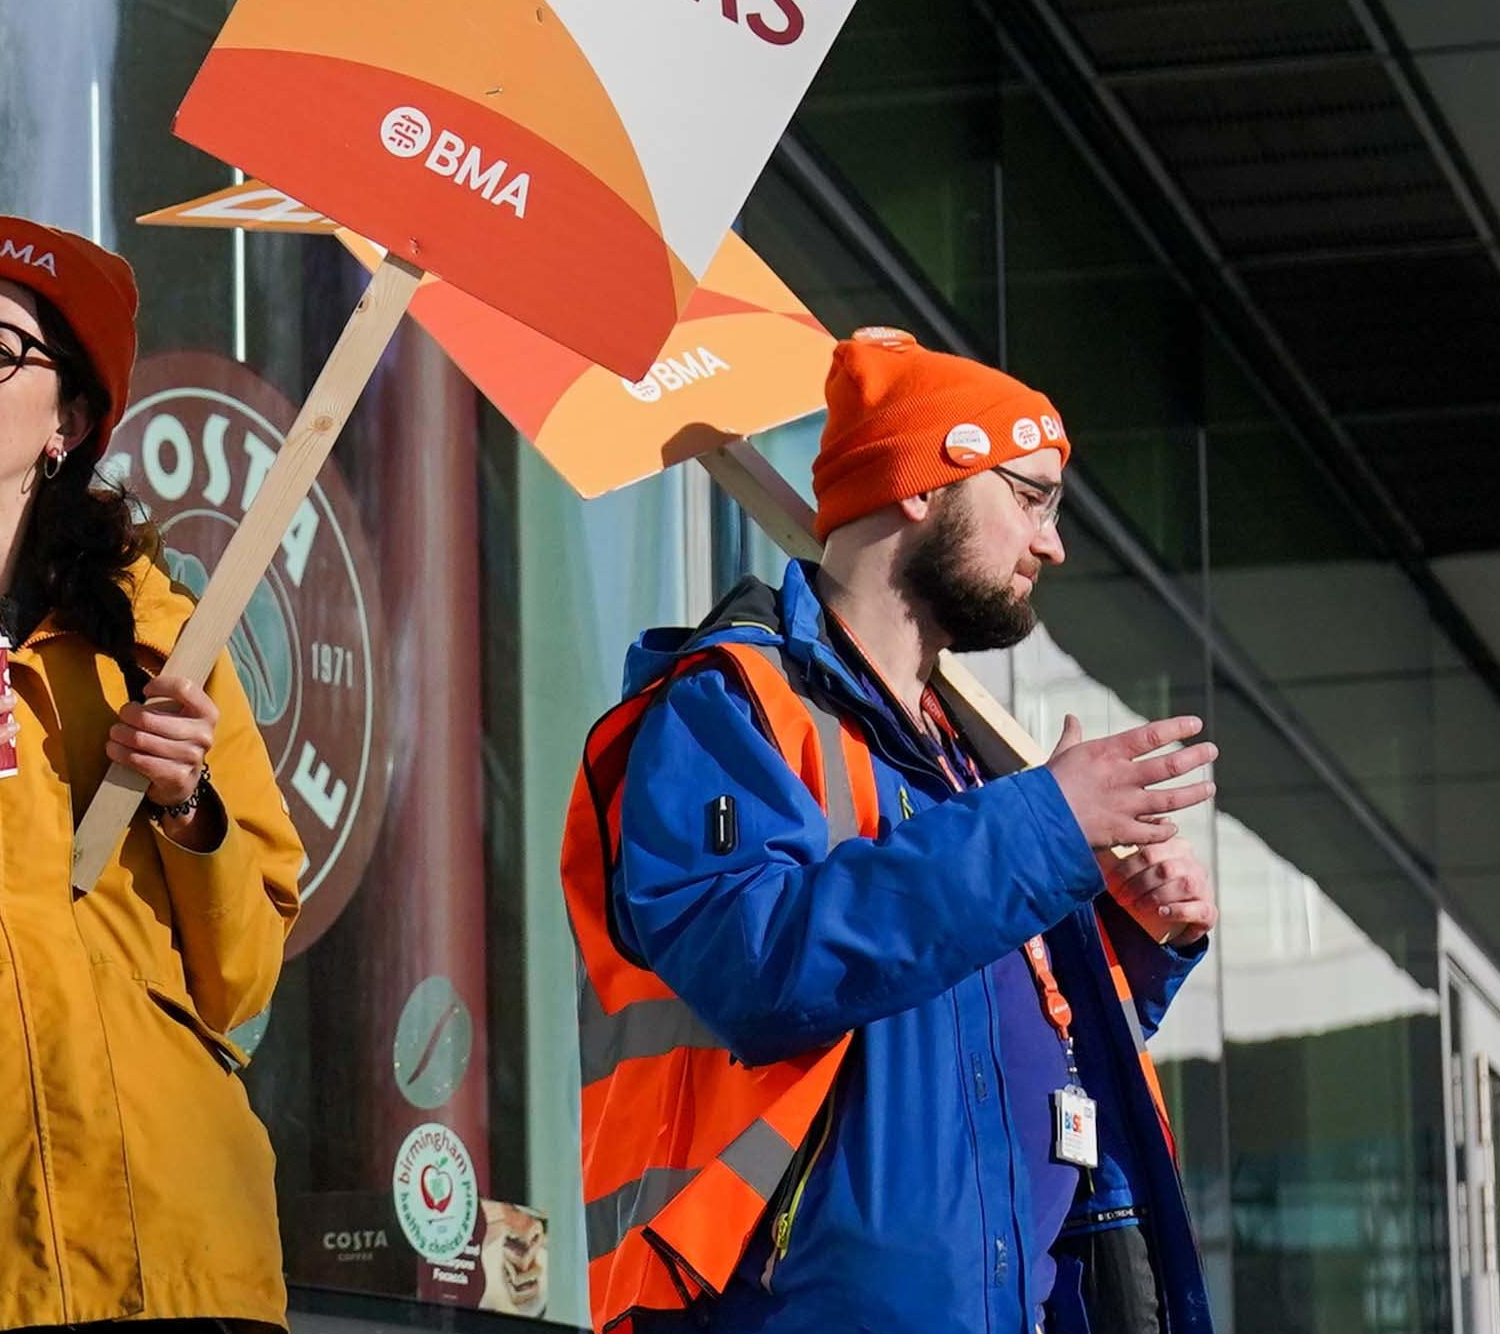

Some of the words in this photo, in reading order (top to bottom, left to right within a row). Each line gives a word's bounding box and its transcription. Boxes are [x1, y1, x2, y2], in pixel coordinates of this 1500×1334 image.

[424, 128, 532, 219] BMA
[651, 347, 731, 392] BMA
[310, 641, 354, 689] 1971
[398, 1131, 468, 1186] birmingham
[323, 1229, 389, 1252] COSTA
